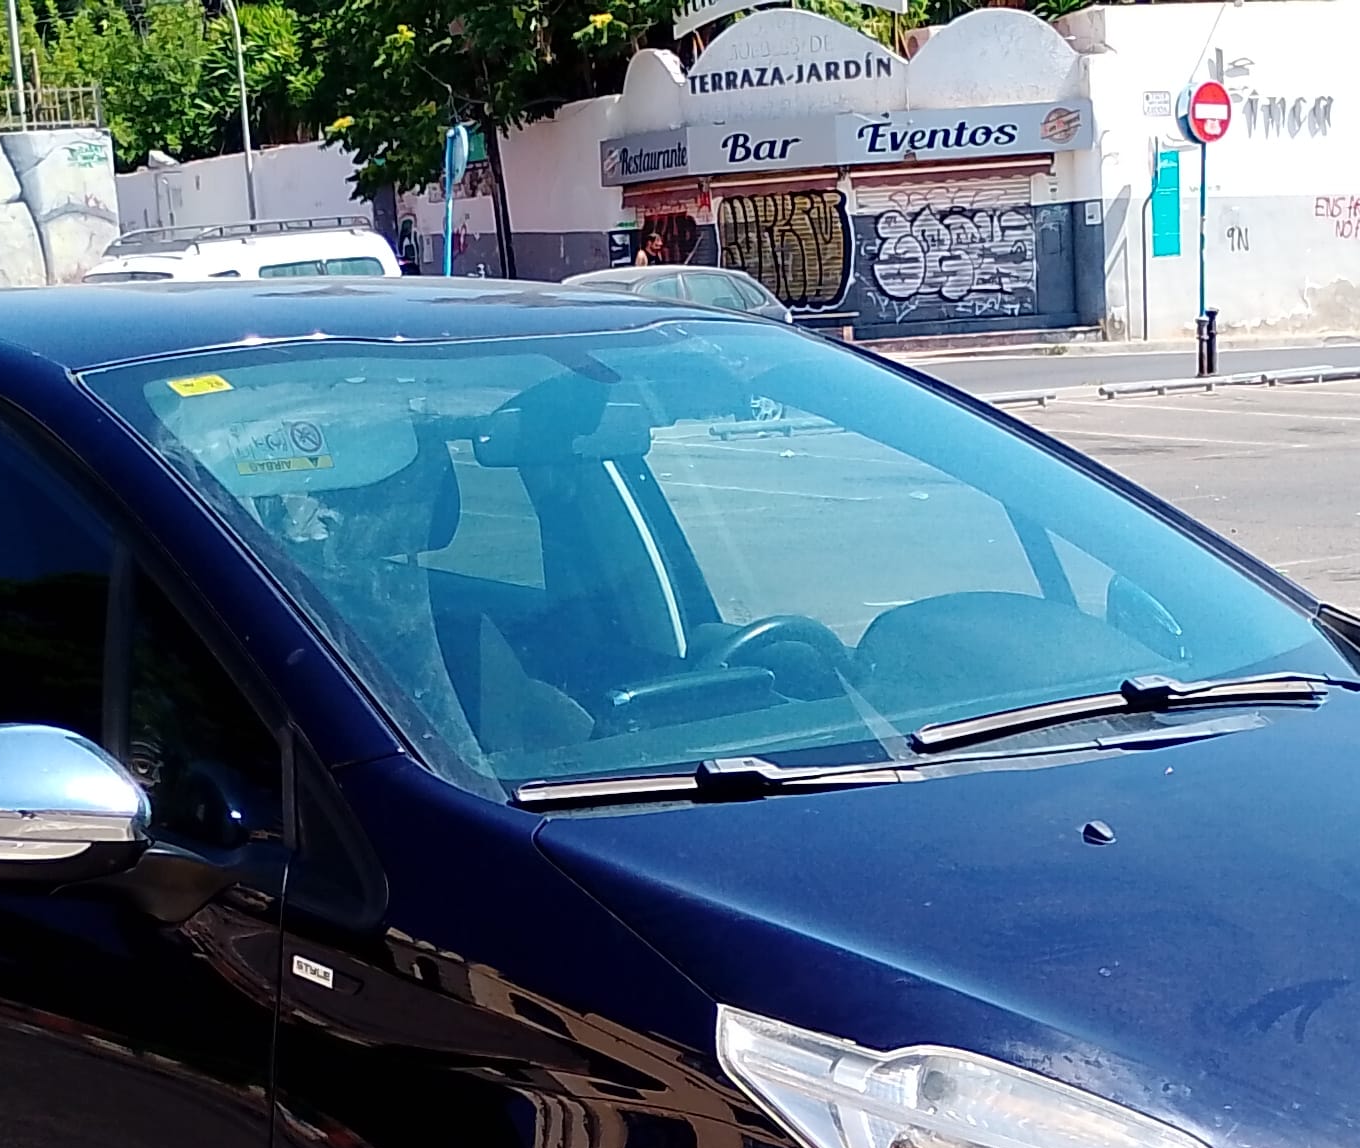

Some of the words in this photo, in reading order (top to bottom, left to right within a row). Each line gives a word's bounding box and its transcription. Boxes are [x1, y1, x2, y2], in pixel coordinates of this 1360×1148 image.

[687, 51, 893, 95] TERRAZA-JARDÍN
[619, 141, 688, 176] Restaurante
[721, 132, 802, 164] Bar
[857, 120, 1019, 153] Eventos
[296, 959, 331, 982] STYLE
